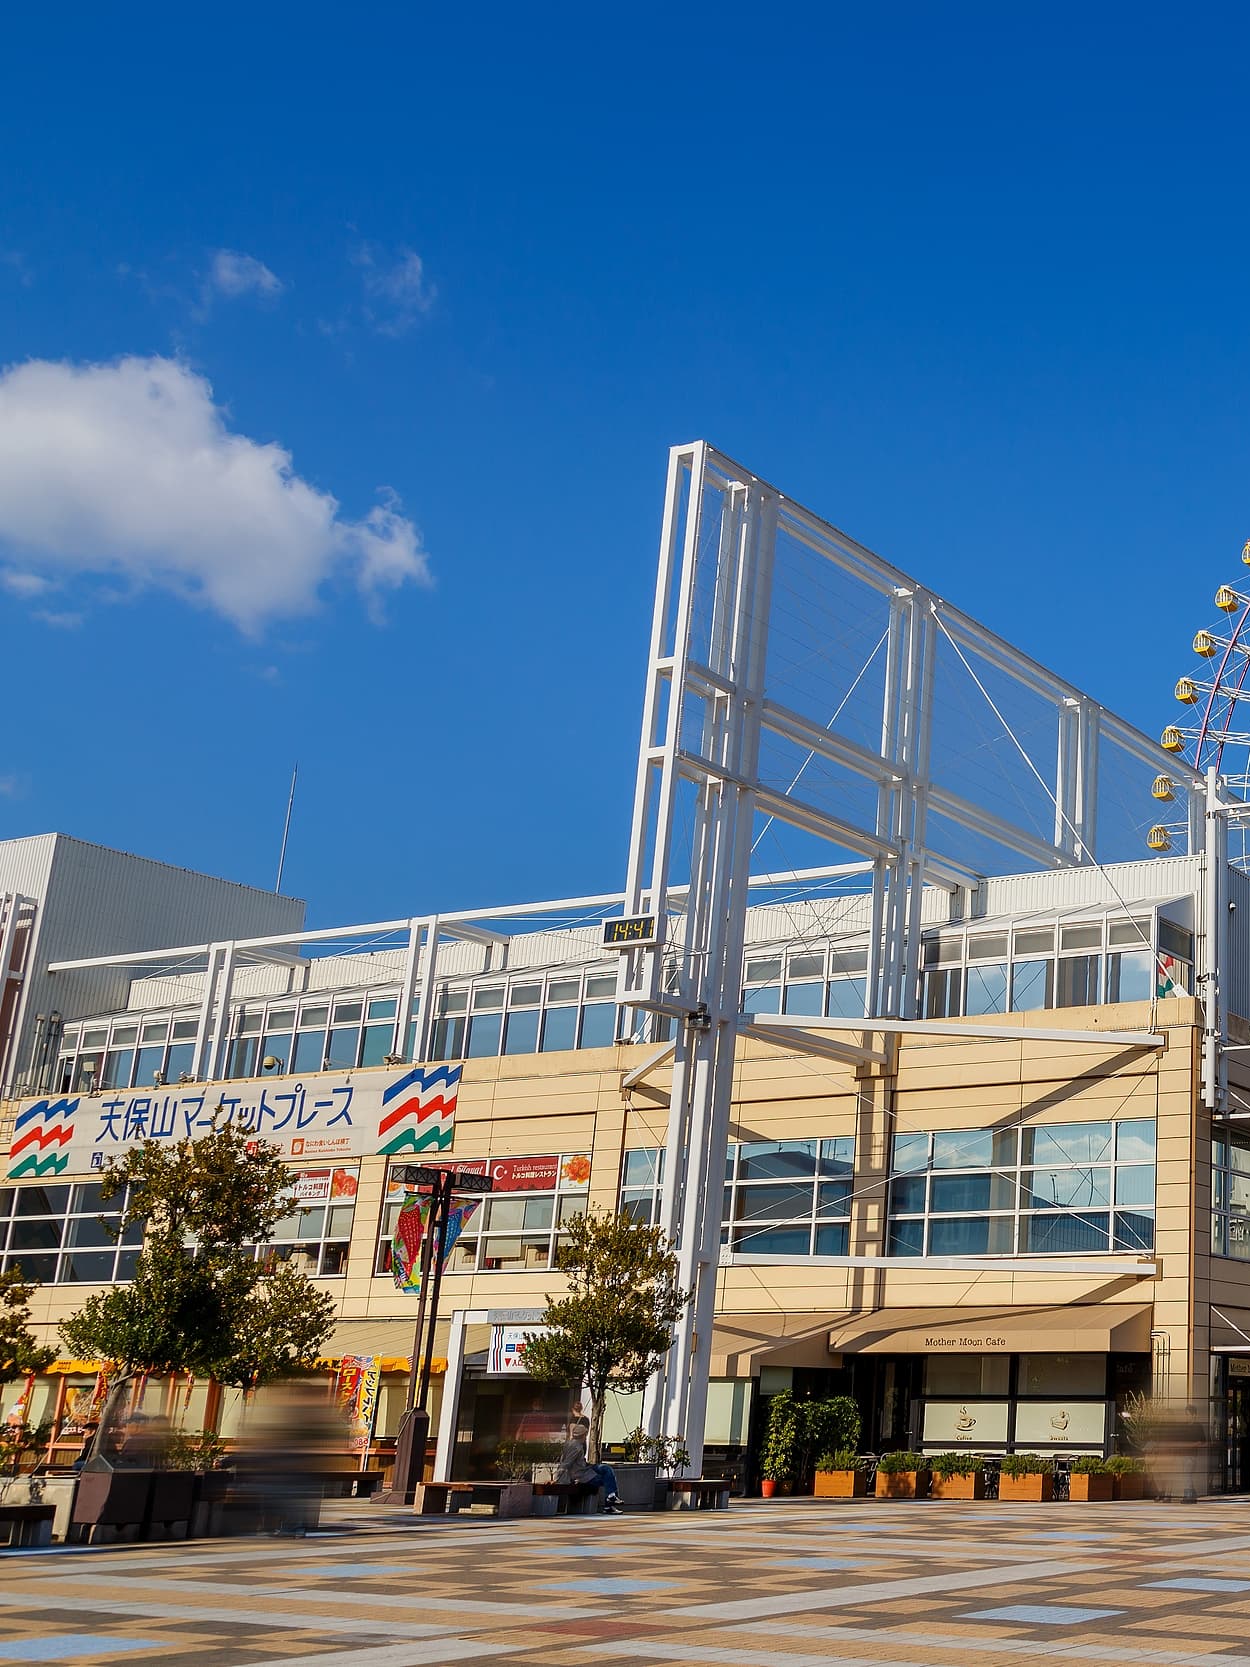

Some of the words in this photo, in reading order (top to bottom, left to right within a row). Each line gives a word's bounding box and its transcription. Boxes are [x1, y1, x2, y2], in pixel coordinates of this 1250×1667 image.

[613, 919, 655, 941] 14:41
[95, 1083, 354, 1142] 天保山マーケットプレース
[925, 1337, 957, 1347] Mother
[959, 1337, 982, 1347] Moon
[985, 1337, 1006, 1346] Cafe
